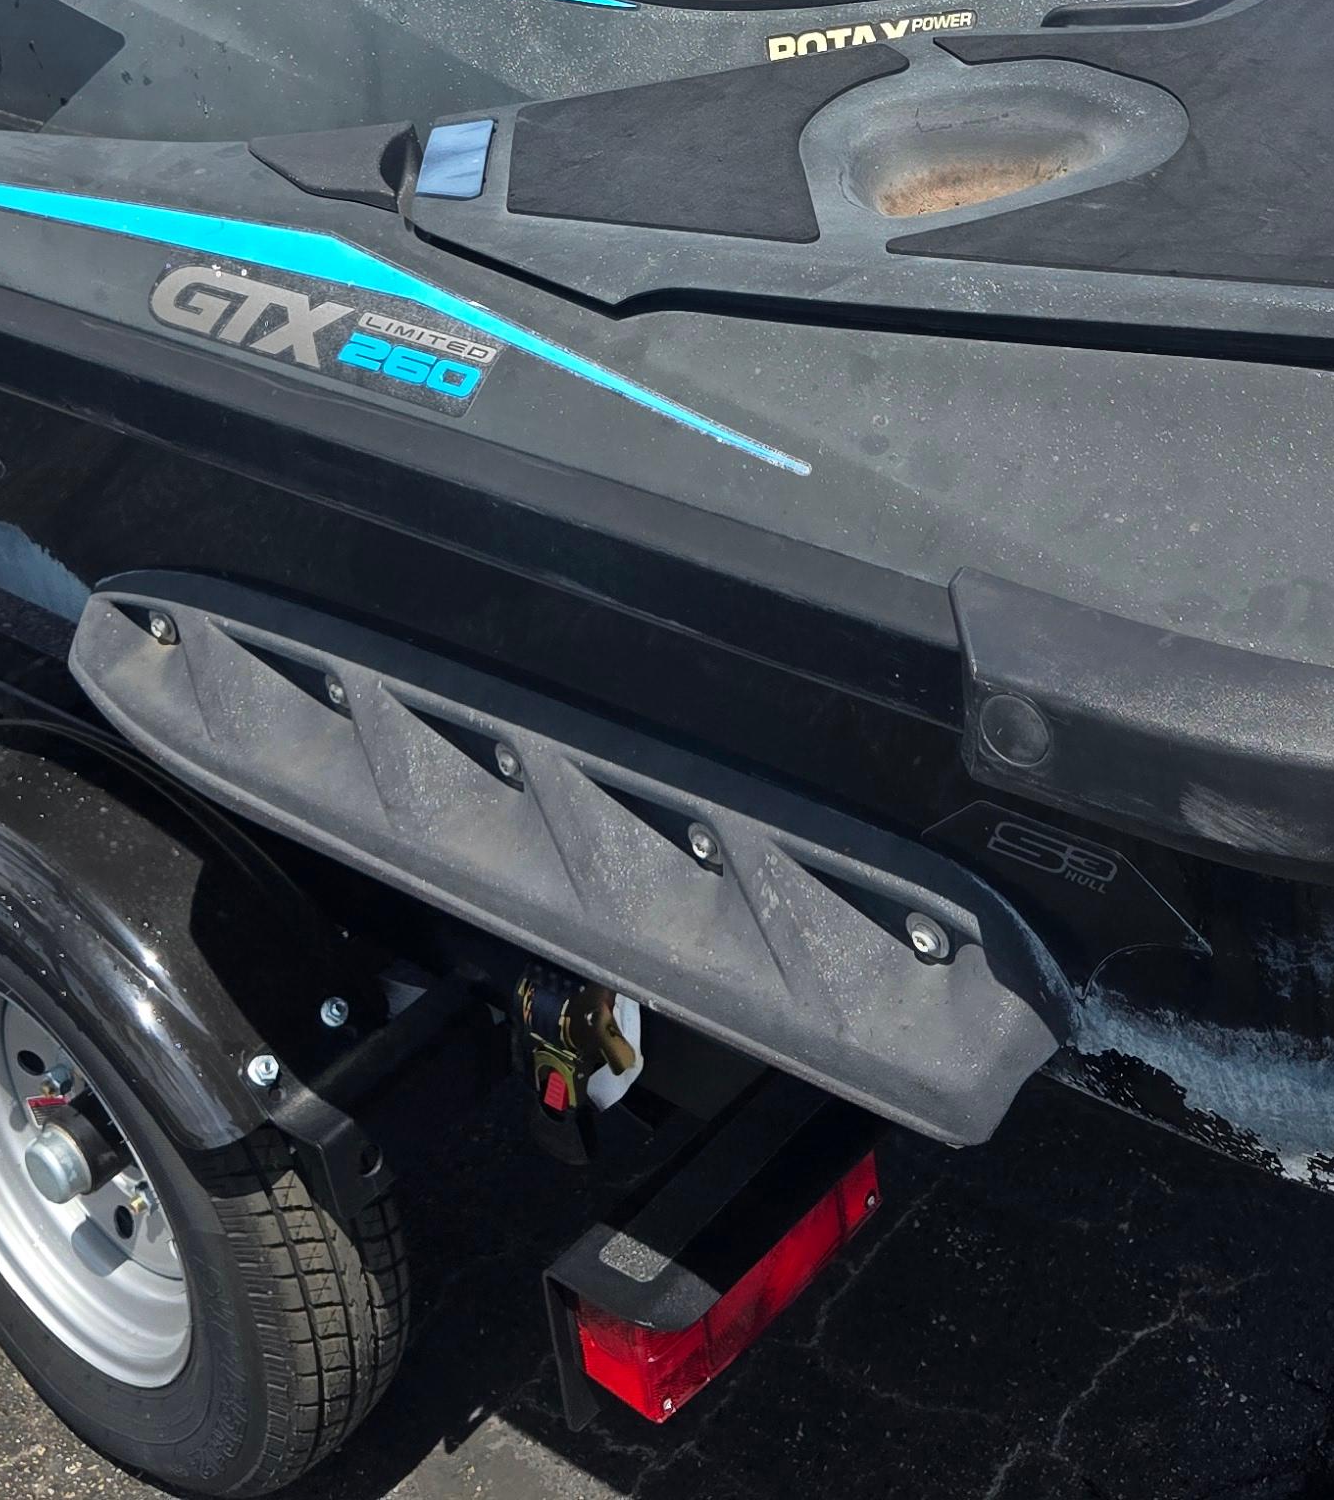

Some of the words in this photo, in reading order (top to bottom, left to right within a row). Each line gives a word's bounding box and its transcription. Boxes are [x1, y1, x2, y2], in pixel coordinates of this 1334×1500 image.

[912, 12, 972, 32] POWER
[151, 266, 356, 368] GTX
[365, 316, 491, 360] LIMITED
[336, 332, 481, 398] 260
[1064, 870, 1107, 894] HULL
